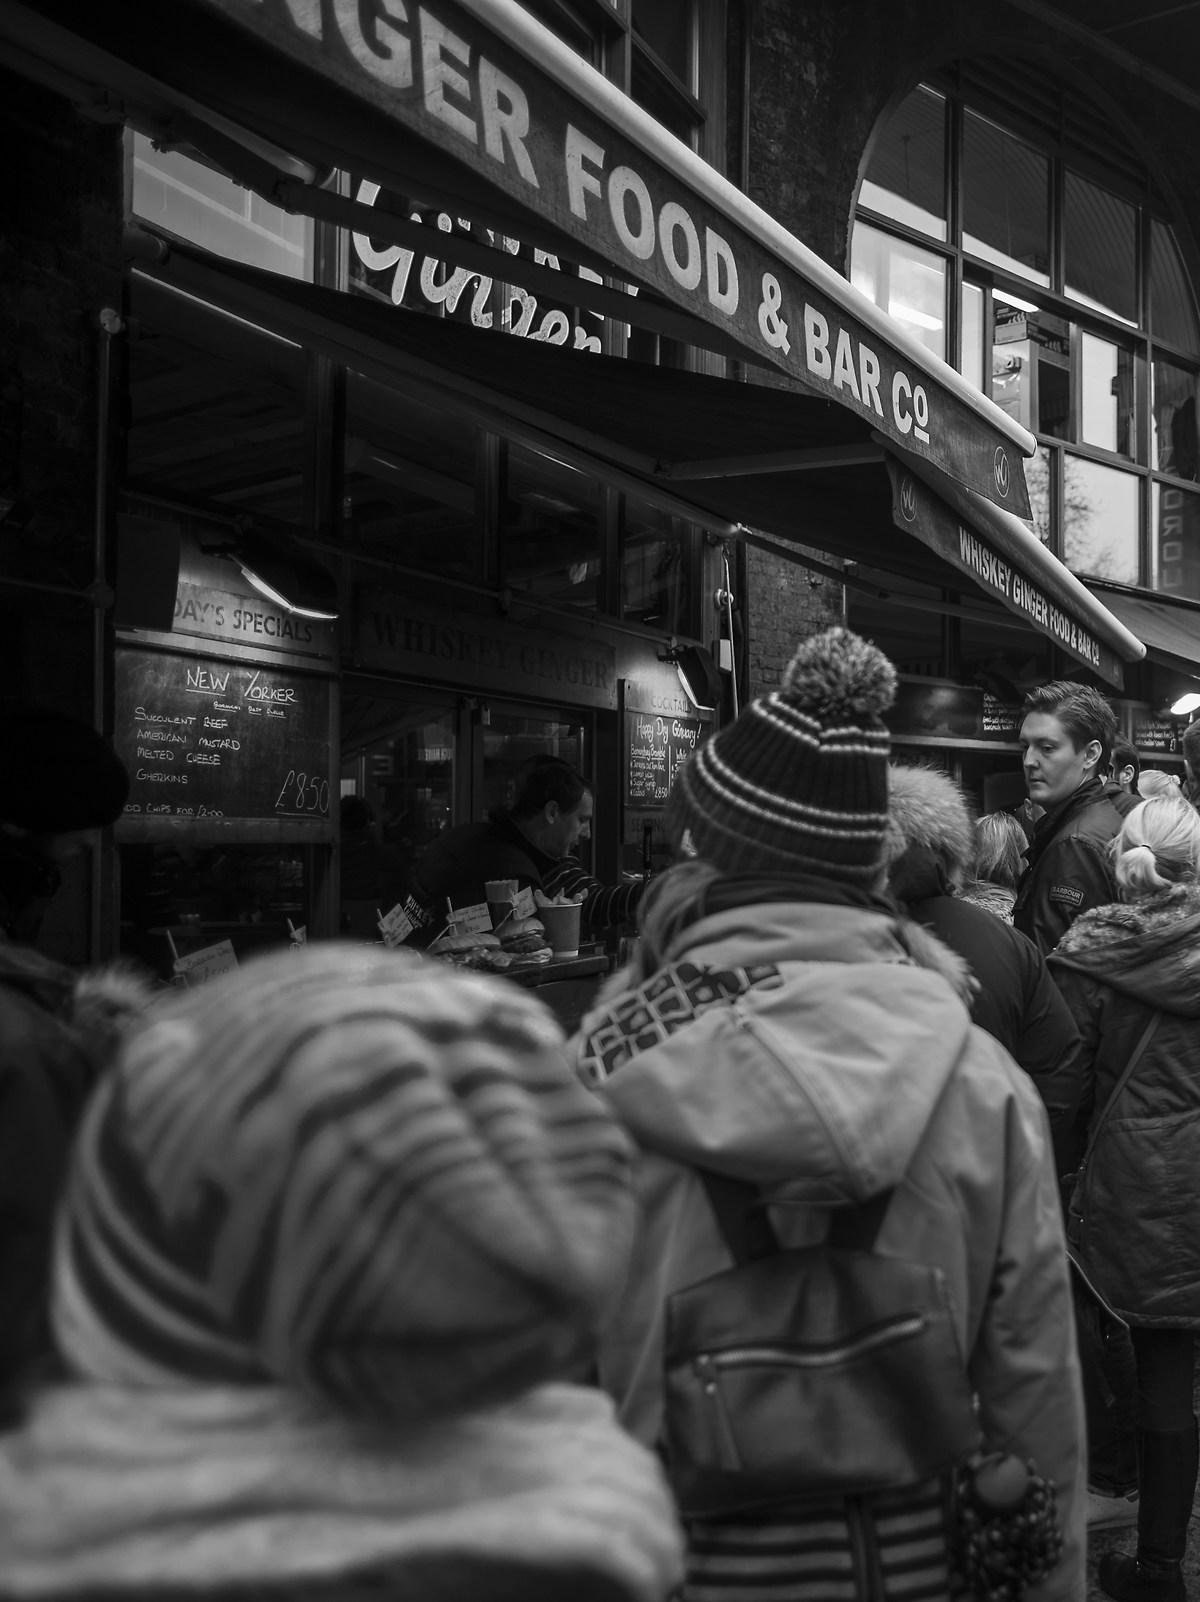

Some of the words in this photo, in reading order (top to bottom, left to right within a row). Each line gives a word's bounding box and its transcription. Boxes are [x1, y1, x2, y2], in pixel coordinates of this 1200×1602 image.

[565, 123, 738, 315] FOOD
[758, 272, 791, 355] &
[804, 303, 884, 417] BAR
[959, 525, 1011, 597] WHISKEY
[1013, 574, 1048, 628] GINGER
[1050, 604, 1070, 644] FOOD
[1071, 623, 1077, 650] &
[1078, 628, 1092, 661] BAR
[233, 609, 313, 643] SPECIALS
[371, 611, 511, 670] WHISKEY
[519, 646, 609, 689] GINGER
[187, 667, 230, 691] NEW
[244, 671, 298, 703] YORKER
[134, 707, 197, 725] SUCCULENT
[203, 717, 229, 729] BEEF
[651, 696, 692, 714] COCKTAILS
[137, 729, 187, 743] AMERICAN
[199, 738, 241, 751] MUSTARD
[637, 714, 654, 743] Happy
[656, 717, 669, 744] Dry
[137, 747, 174, 760] MELTED
[186, 753, 221, 765] CHEESE
[136, 768, 188, 784] GHERKINS
[123, 804, 141, 812] DD
[146, 803, 171, 813] CHIPS
